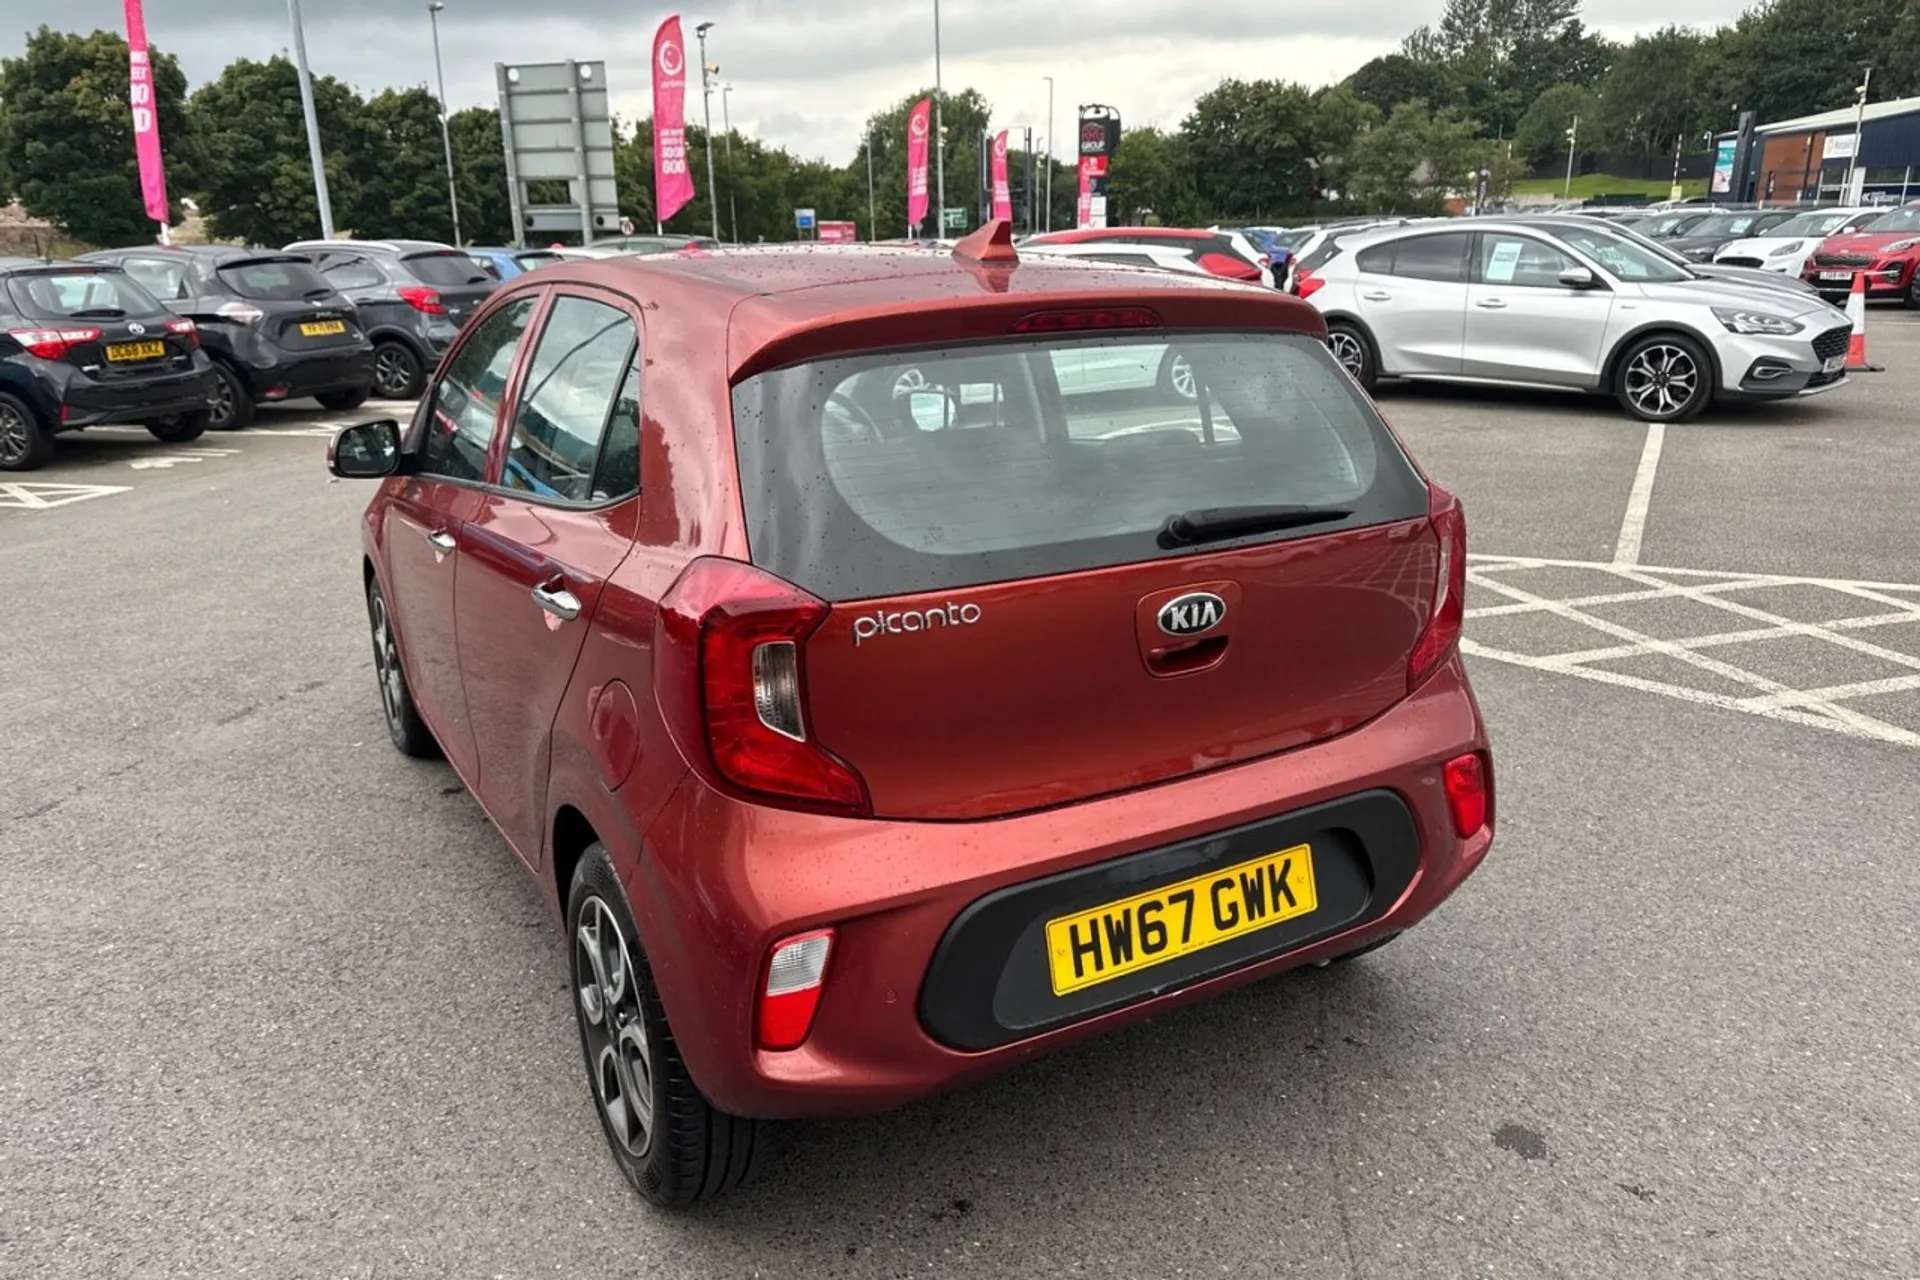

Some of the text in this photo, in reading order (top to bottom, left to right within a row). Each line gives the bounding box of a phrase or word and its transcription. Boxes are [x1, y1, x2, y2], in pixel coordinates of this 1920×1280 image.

[854, 601, 981, 647] picanto
[1170, 600, 1217, 630] KIA
[1069, 858, 1297, 979] HW67 GWK
